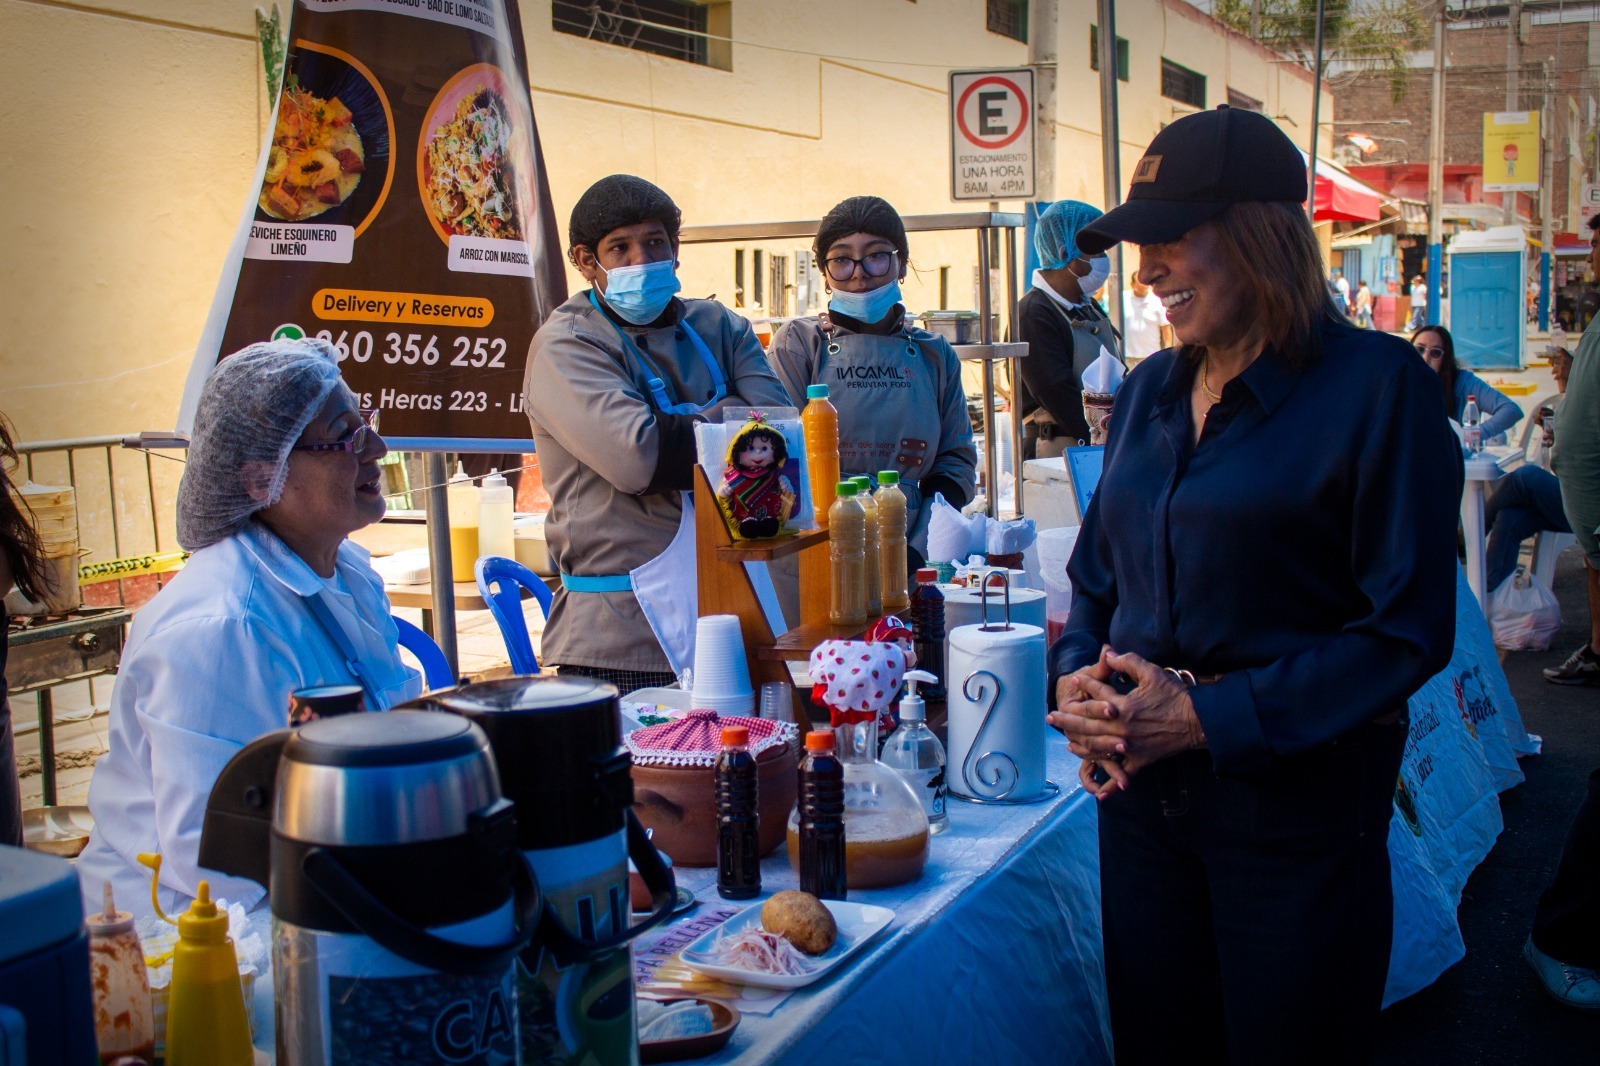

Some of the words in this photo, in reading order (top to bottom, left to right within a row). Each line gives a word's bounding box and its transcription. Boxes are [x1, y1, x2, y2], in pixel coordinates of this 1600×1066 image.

[427, 0, 442, 12] BAO
[444, 1, 454, 15] DE
[455, 5, 473, 20] LOMO
[979, 91, 1008, 136] E
[959, 154, 1028, 164] ESTACIONAMIENTO
[962, 167, 987, 178] UNA
[990, 165, 1024, 177] HORA
[963, 182, 988, 193] 8AM
[1000, 180, 1025, 192] 4PM
[249, 226, 282, 240] EVICHE
[284, 228, 337, 242] ESQUINERO
[270, 241, 307, 256] LIMEÑO
[459, 247, 484, 260] ARROZ
[484, 250, 499, 262] CON
[323, 295, 392, 317] Delivery
[396, 302, 406, 318] y
[411, 300, 484, 320] Reservas
[382, 332, 441, 366] 356
[450, 336, 507, 369] 252
[847, 381, 888, 389] PERUVIAN
[379, 388, 443, 411] Heras
[448, 391, 488, 412] 223
[651, 911, 738, 956] RELLENA
